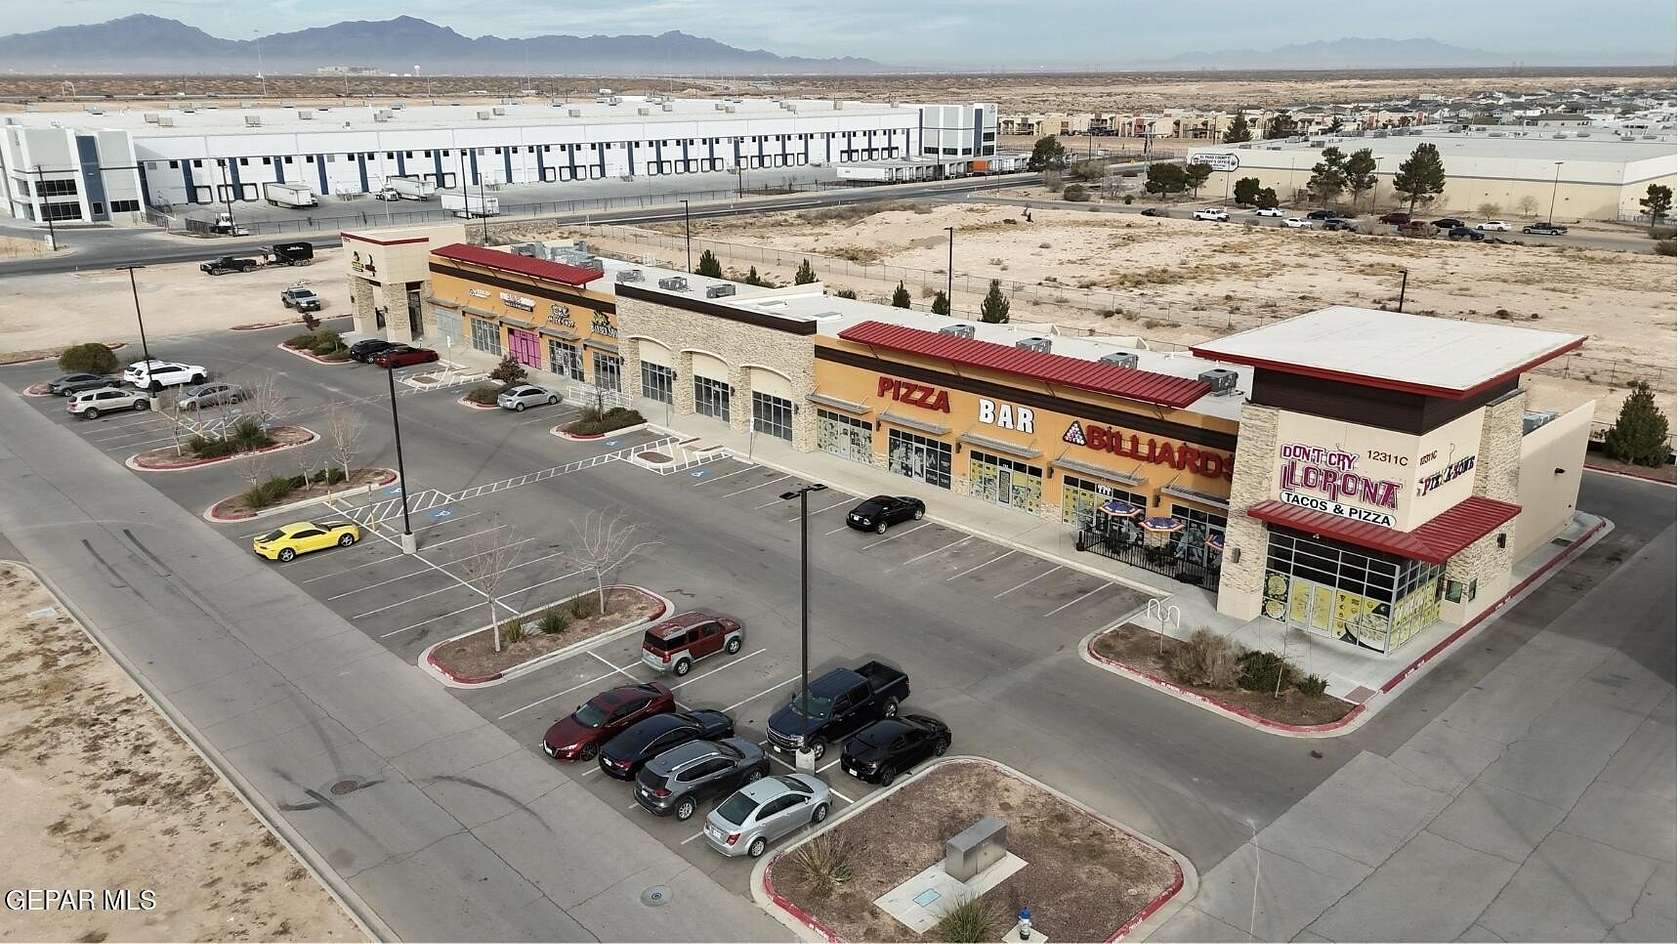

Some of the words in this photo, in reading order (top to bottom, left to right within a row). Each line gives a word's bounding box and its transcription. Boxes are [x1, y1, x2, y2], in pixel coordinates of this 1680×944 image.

[877, 376, 951, 414] PIZZA
[978, 399, 1034, 434] BAR
[1085, 424, 1233, 478] BILLIARDS
[1327, 450, 1359, 471] CRY
[1367, 449, 1409, 467] 12311C
[1280, 460, 1402, 509] LLORONA
[1284, 492, 1328, 511] TACOS
[1332, 504, 1344, 516] &
[1348, 507, 1391, 527] PIZZA
